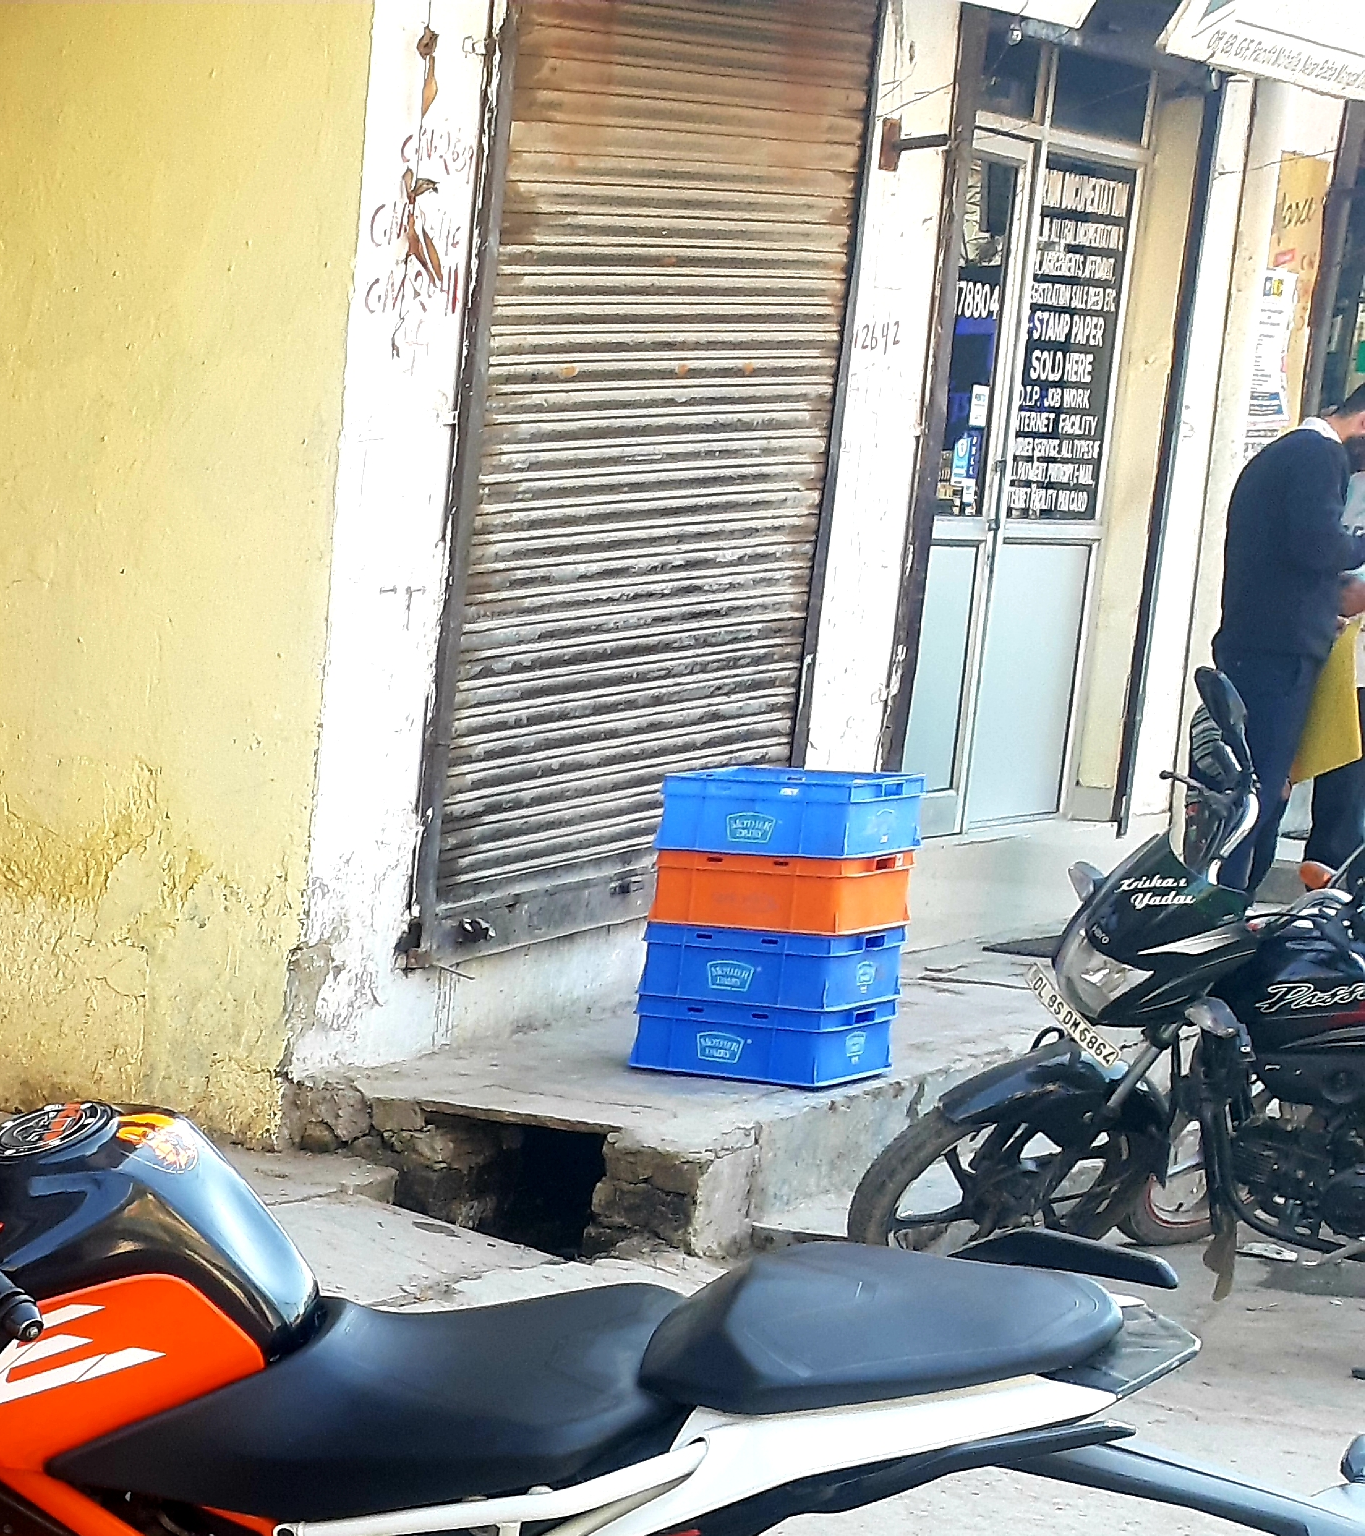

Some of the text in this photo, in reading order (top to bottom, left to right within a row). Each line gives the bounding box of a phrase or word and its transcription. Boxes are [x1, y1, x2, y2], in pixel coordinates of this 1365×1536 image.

[954, 281, 1000, 319] 78804
[1071, 316, 1105, 347] PAPER
[1030, 349, 1094, 383] SOLD HERE
[1043, 386, 1062, 407] JOB
[1062, 387, 1091, 409] WORK
[1058, 412, 1097, 436] FACILITY
